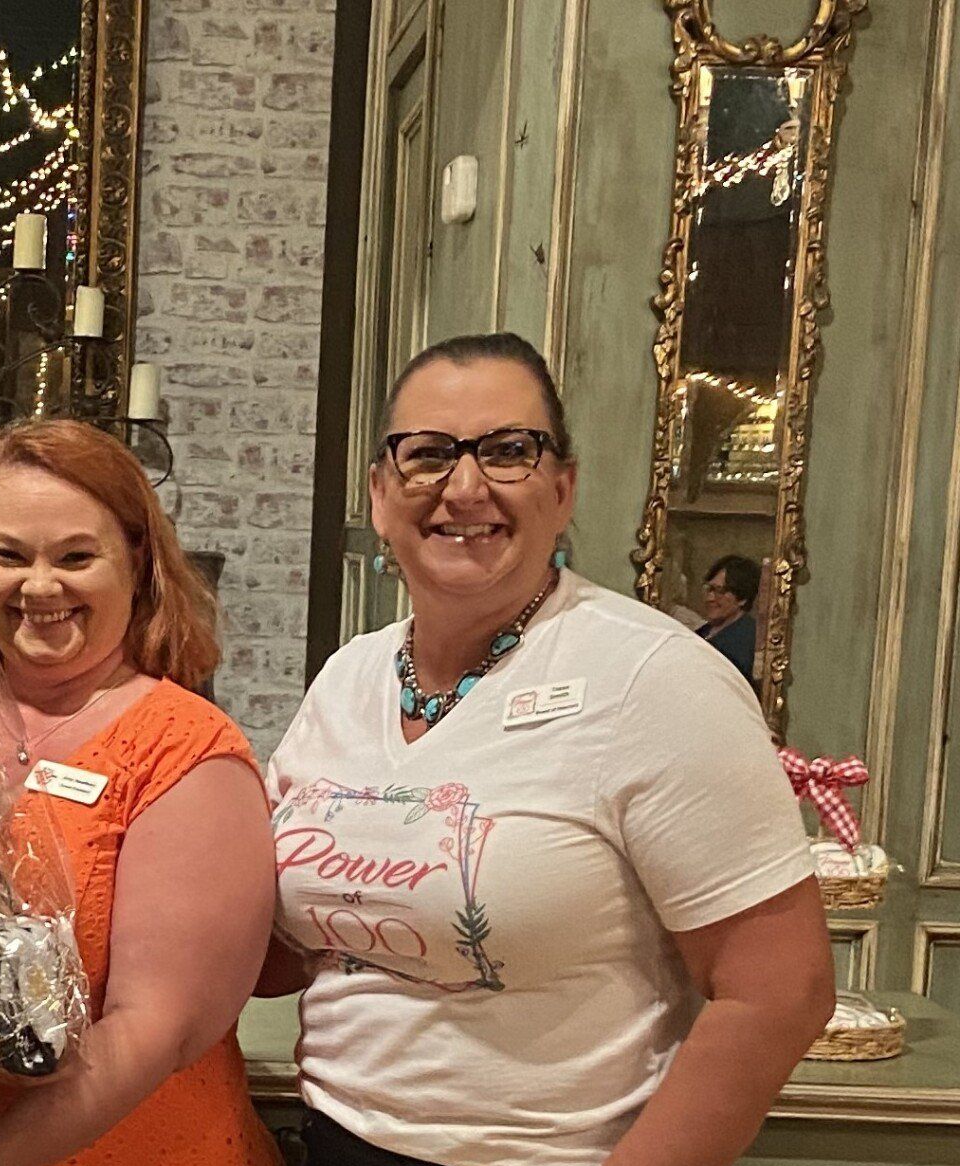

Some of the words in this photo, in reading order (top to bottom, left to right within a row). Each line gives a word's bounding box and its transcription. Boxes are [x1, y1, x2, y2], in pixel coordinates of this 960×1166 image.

[275, 827, 448, 890] Power
[342, 890, 363, 905] of
[307, 907, 427, 957] 100
